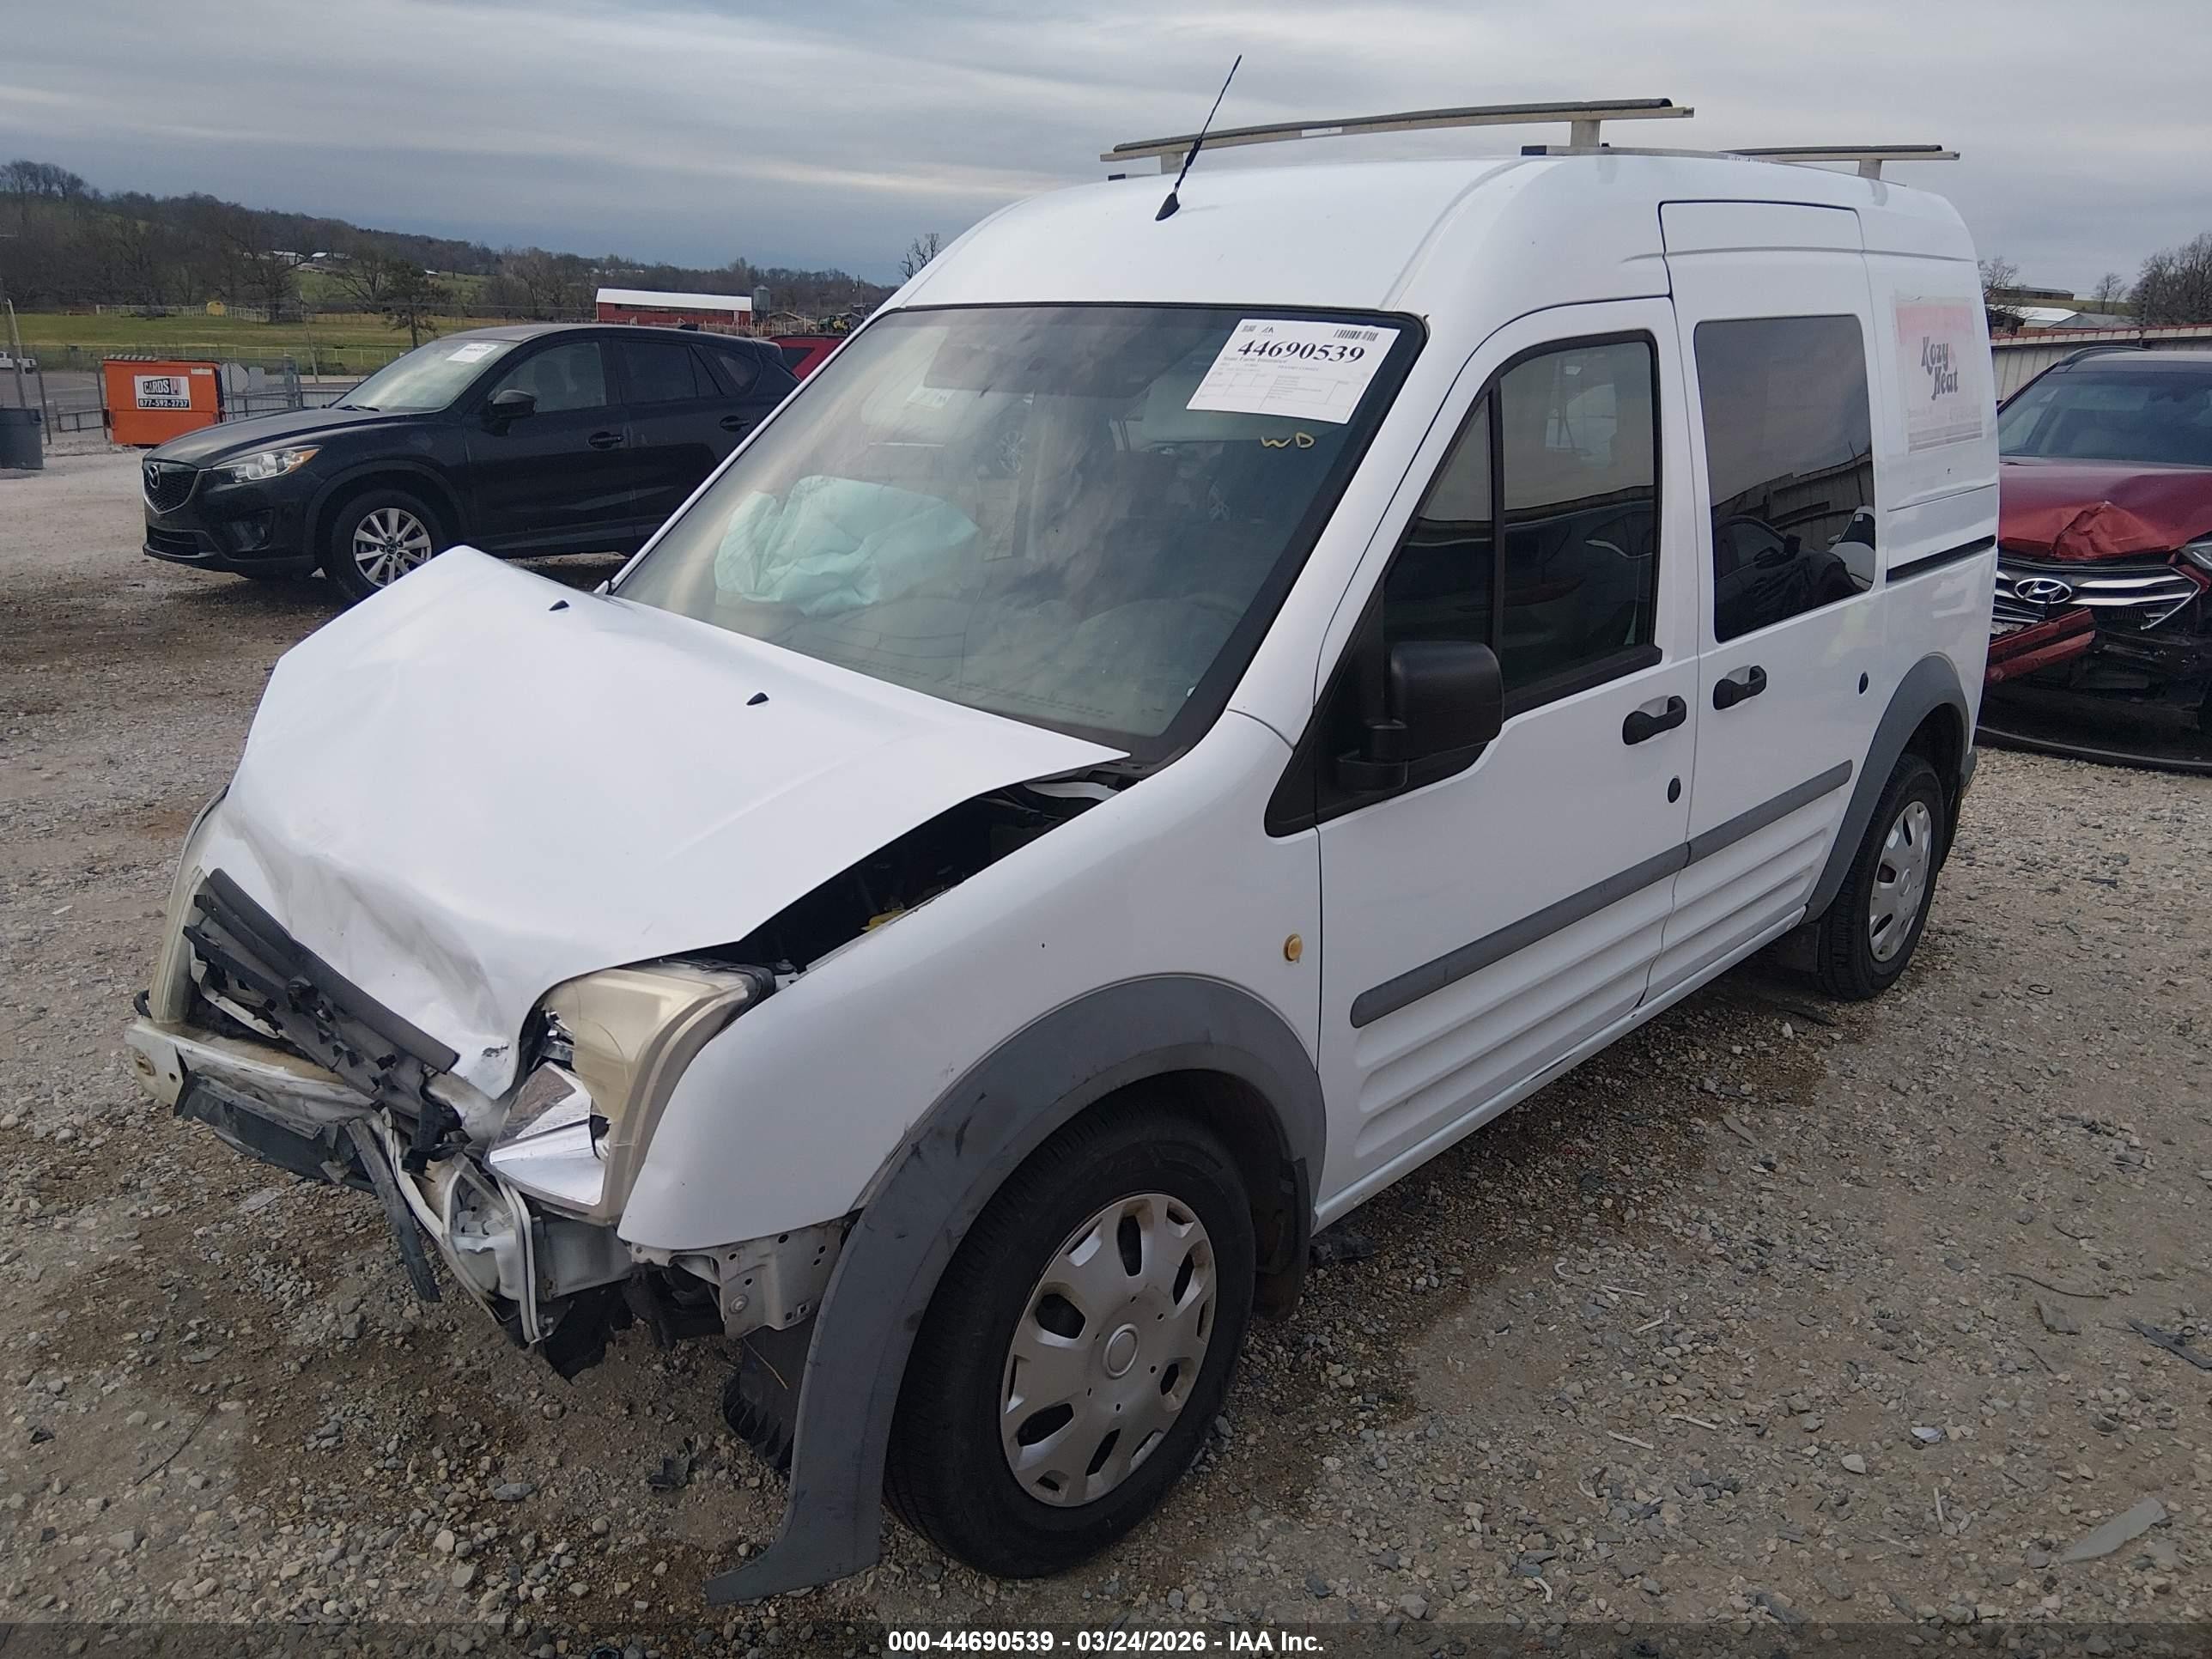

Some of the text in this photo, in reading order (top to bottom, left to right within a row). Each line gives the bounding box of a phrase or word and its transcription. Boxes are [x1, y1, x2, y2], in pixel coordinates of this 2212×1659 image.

[1237, 339, 1365, 364] 44690539
[1920, 336, 1949, 375] Kozy
[144, 380, 170, 393] CARDS
